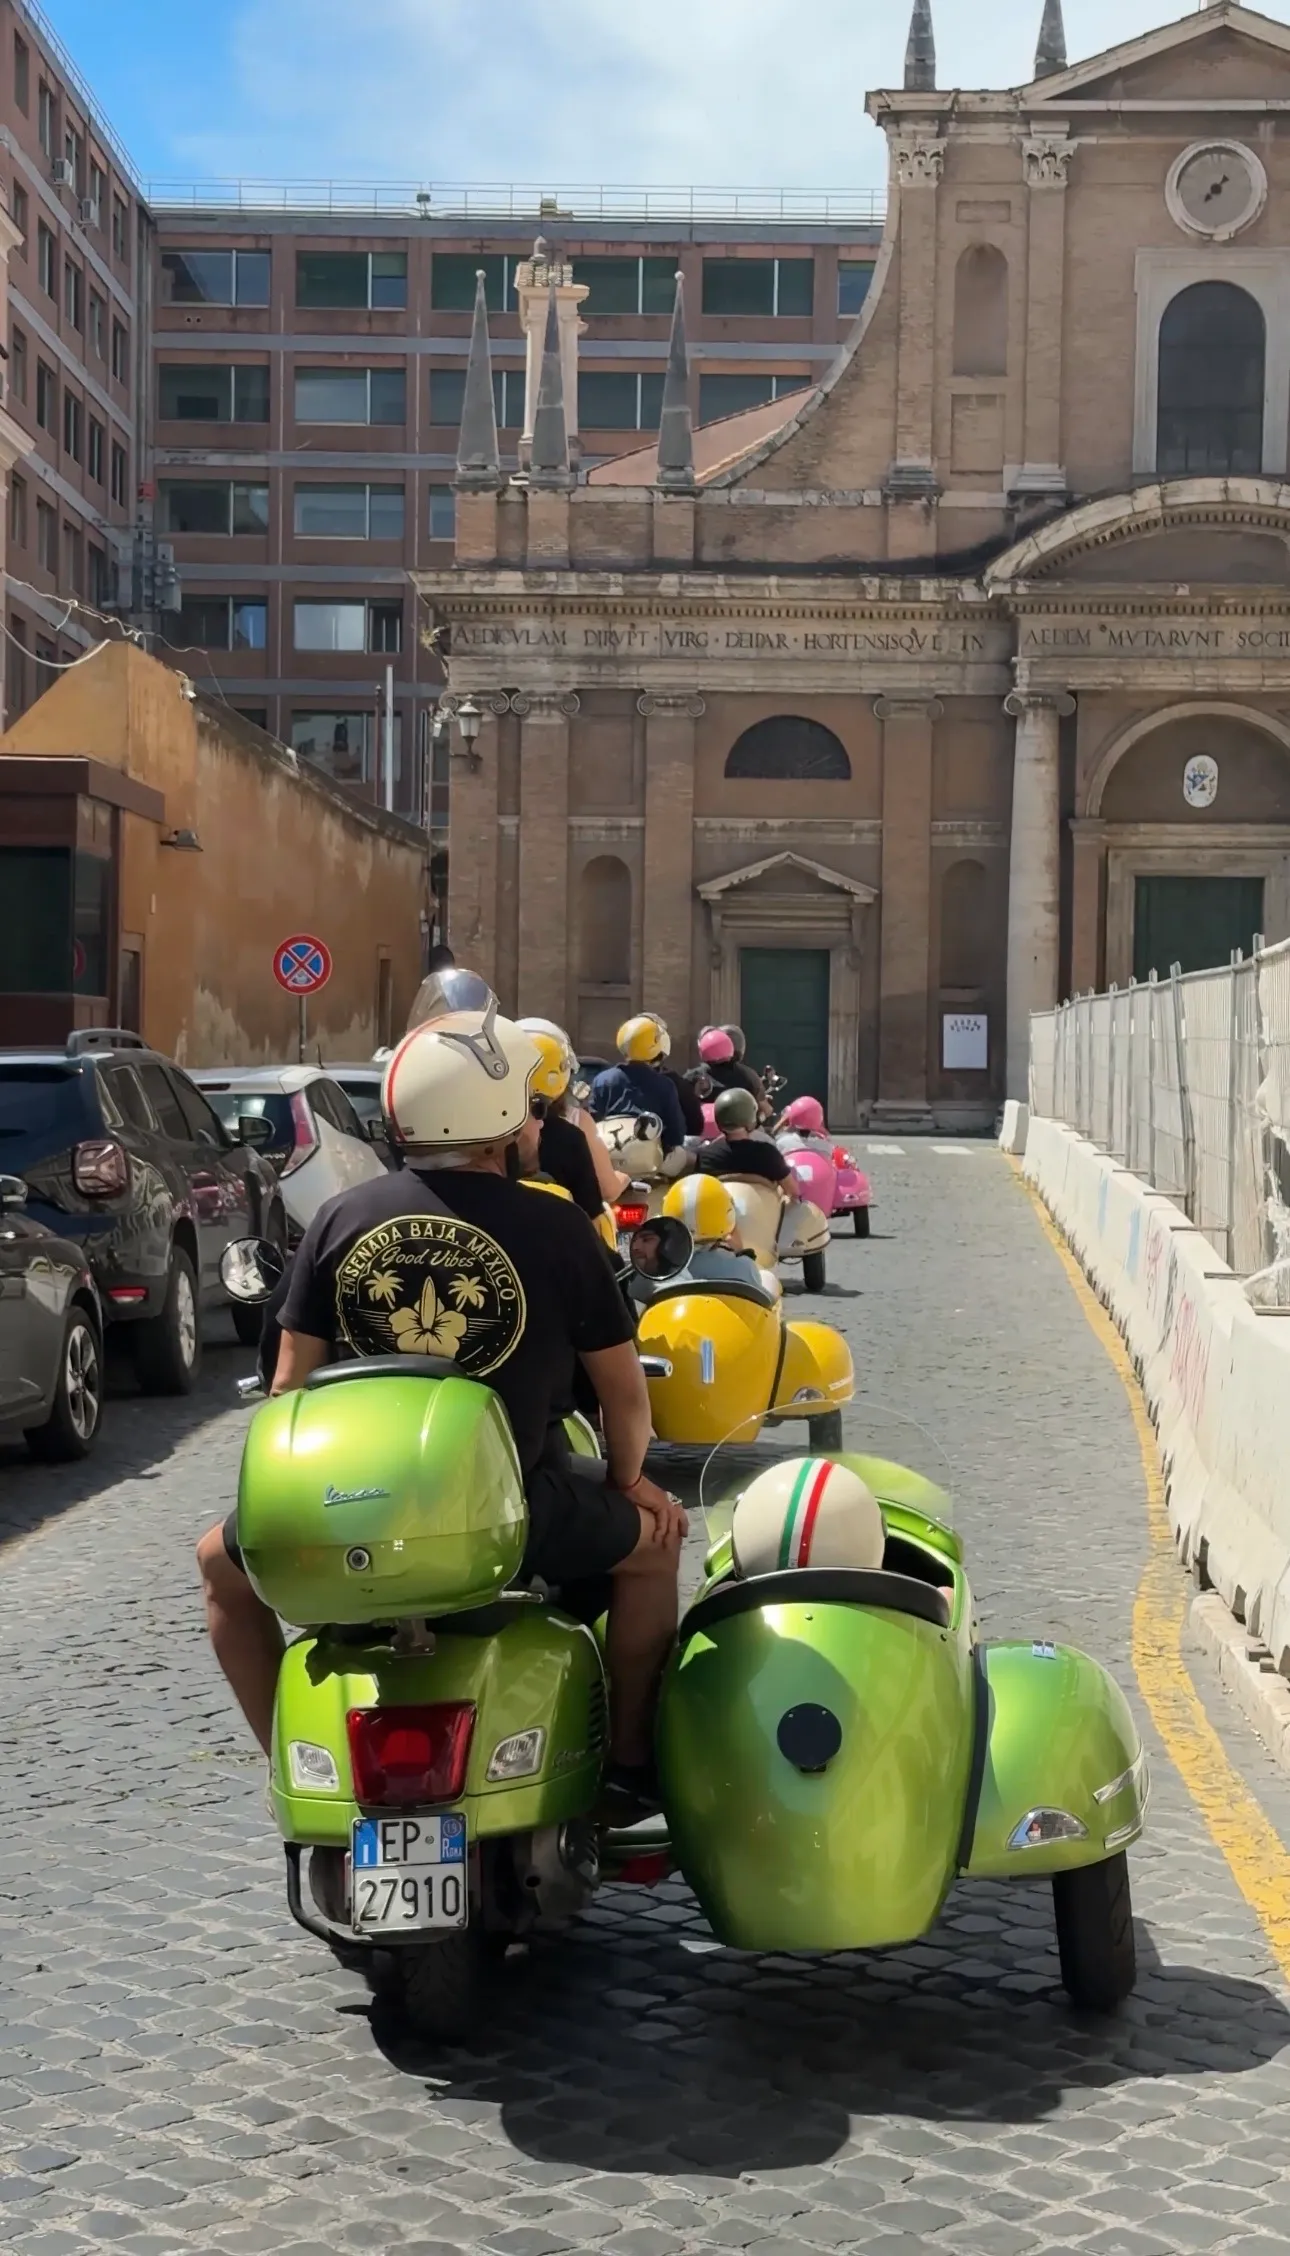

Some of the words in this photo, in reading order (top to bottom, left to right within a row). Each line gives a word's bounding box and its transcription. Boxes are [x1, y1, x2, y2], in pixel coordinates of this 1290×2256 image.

[961, 634, 986, 651] IN
[1109, 630, 1225, 648] MVTARVNT
[342, 1226, 403, 1295] ENSENADA
[466, 1236, 516, 1300] MEXICO
[382, 1247, 430, 1268] Good
[430, 1250, 476, 1268] Vibes
[382, 1821, 421, 1862] EP
[359, 1875, 460, 1921] 27910
